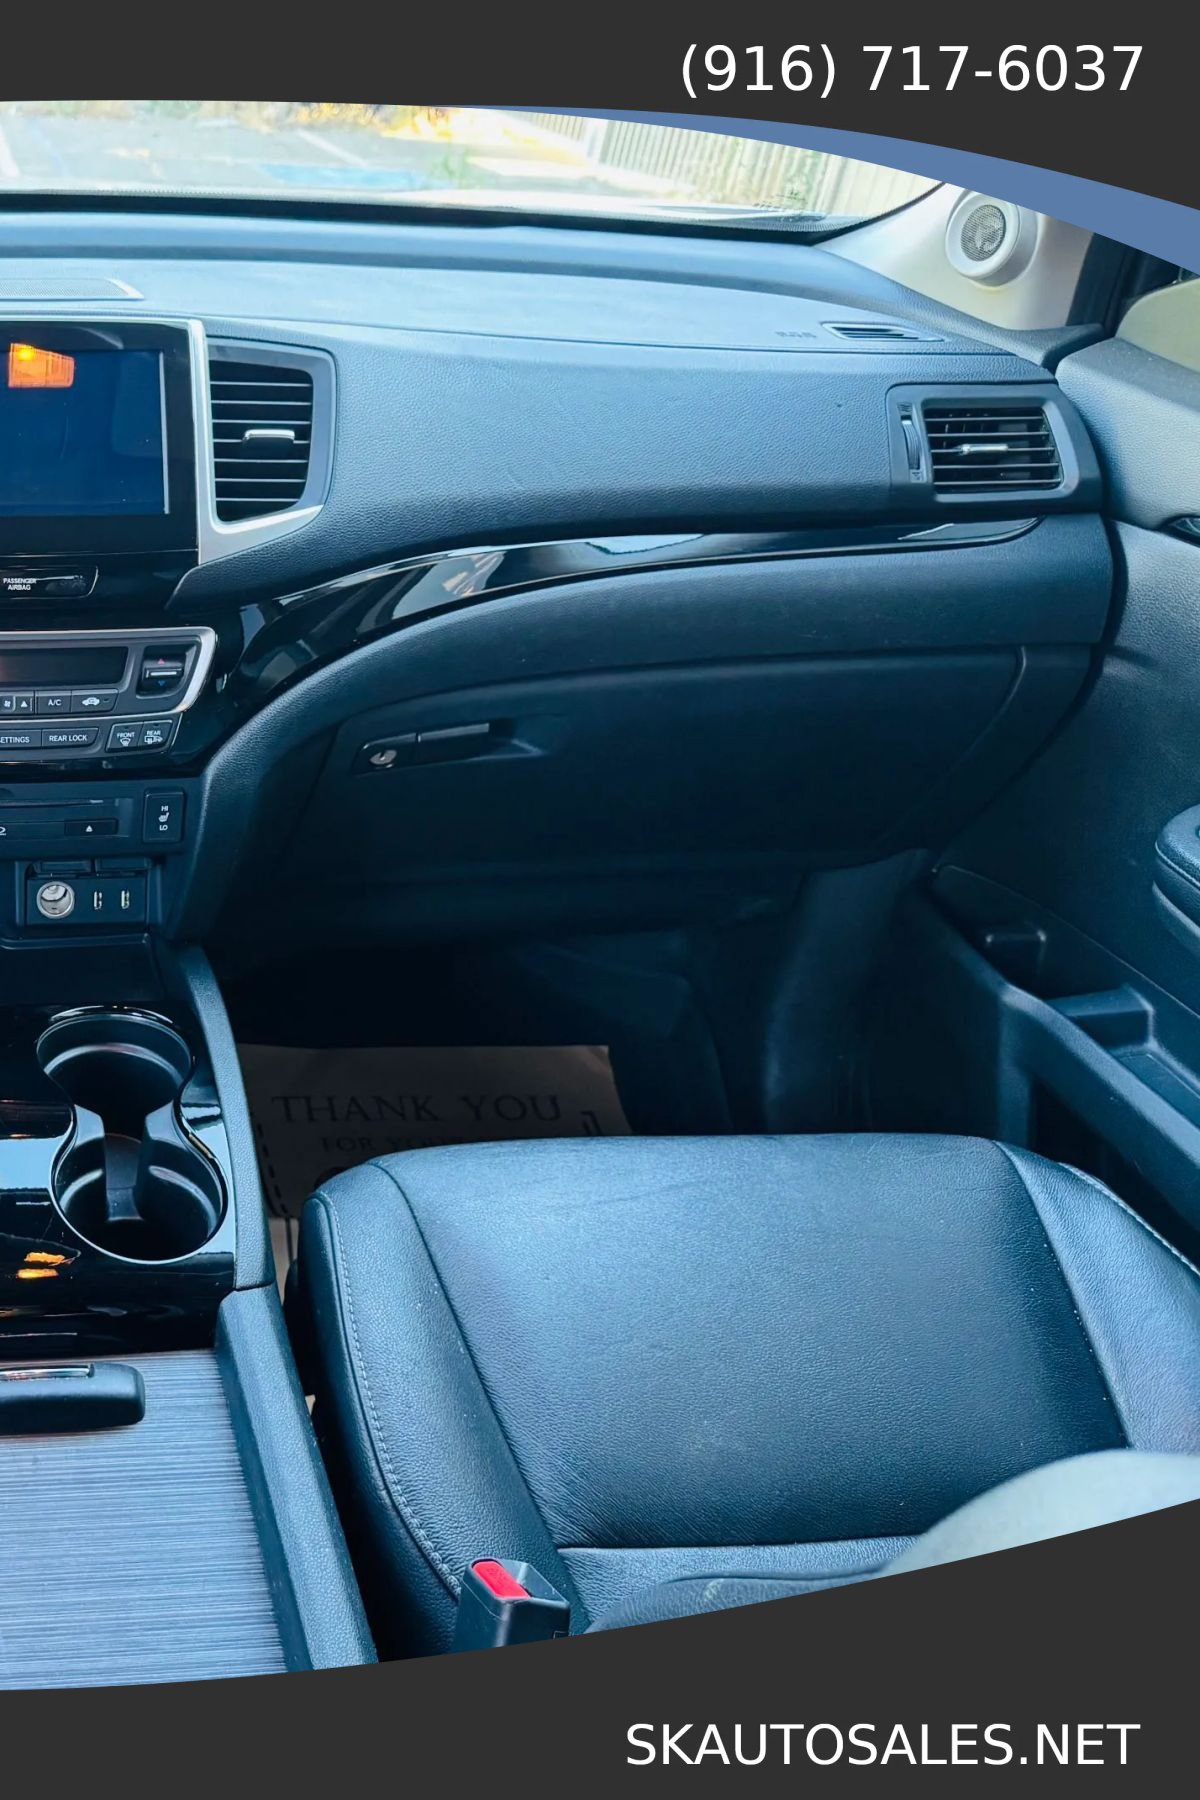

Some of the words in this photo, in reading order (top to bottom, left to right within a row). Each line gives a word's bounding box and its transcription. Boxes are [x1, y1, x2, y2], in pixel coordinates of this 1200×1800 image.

[48, 699, 62, 707] A/C
[48, 735, 67, 743] REAR
[68, 734, 88, 742] LOCK
[116, 731, 135, 739] FRONT
[271, 1095, 440, 1124] THANK
[458, 1094, 562, 1122] YOU
